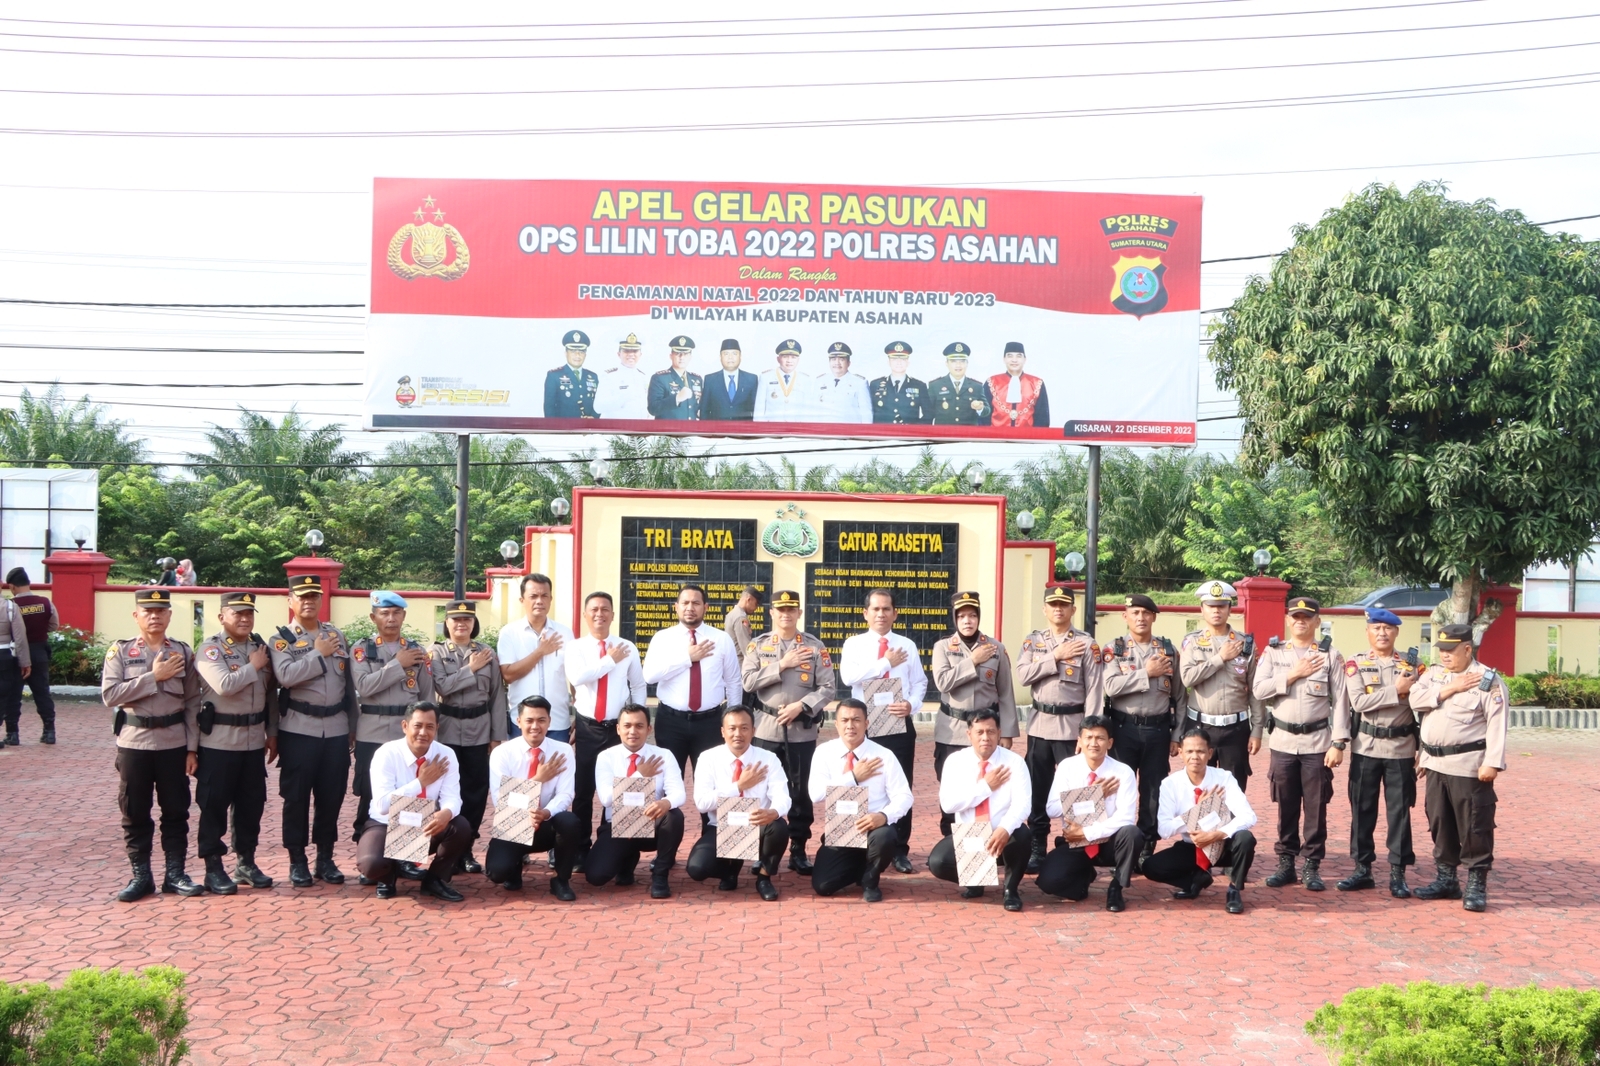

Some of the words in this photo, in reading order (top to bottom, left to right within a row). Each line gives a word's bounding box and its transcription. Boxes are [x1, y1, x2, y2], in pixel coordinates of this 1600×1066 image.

[592, 190, 683, 221] APEL
[692, 191, 811, 223] GELAR
[821, 194, 987, 228] PASUKAN
[1105, 214, 1170, 230] POLRES
[1118, 225, 1157, 233] ASAHAN
[518, 225, 578, 254] OPS
[585, 227, 656, 254] LILIN
[663, 228, 738, 256] TOBA
[744, 229, 816, 258] 2022
[823, 231, 936, 261] POLRES
[941, 234, 1058, 264] ASAHAN
[1110, 239, 1145, 249] SUMATERA
[1146, 240, 1167, 250] UTARA
[738, 265, 783, 280] Dalam
[788, 266, 838, 285] Rangka
[579, 285, 698, 300] PENGAMANAN
[702, 287, 754, 301] NATAL
[758, 288, 800, 302] 2022
[804, 289, 839, 303] DAN
[844, 290, 899, 304] TAHUN
[903, 291, 949, 305] BARU
[953, 293, 995, 307] 2023
[651, 306, 667, 320] DI
[673, 307, 747, 321] WILAYAH
[752, 308, 849, 324] KABUPATEN
[854, 311, 923, 325] ASAHAN
[421, 389, 511, 403] PRESISI
[1074, 424, 1113, 434] KISARAN,
[1115, 425, 1124, 433] 22
[1126, 425, 1172, 434] DESEMBER
[1174, 426, 1192, 435] 2022
[644, 528, 672, 548] TRI
[681, 529, 734, 549] BRATA
[839, 532, 878, 552] CATUR
[881, 533, 943, 553] PRASETYA
[630, 563, 646, 572] KAMI
[647, 563, 667, 572] POLISI
[668, 564, 699, 573] INDONESIA
[850, 569, 883, 577] BHAYANGKARA
[885, 570, 916, 578] KEHORMATAN
[930, 571, 949, 579] ADALAH
[636, 582, 660, 590] BERBAKTI
[814, 579, 847, 587] BERKORBAN
[864, 580, 895, 588] MASYARAKAT
[897, 581, 917, 589] BANGSA
